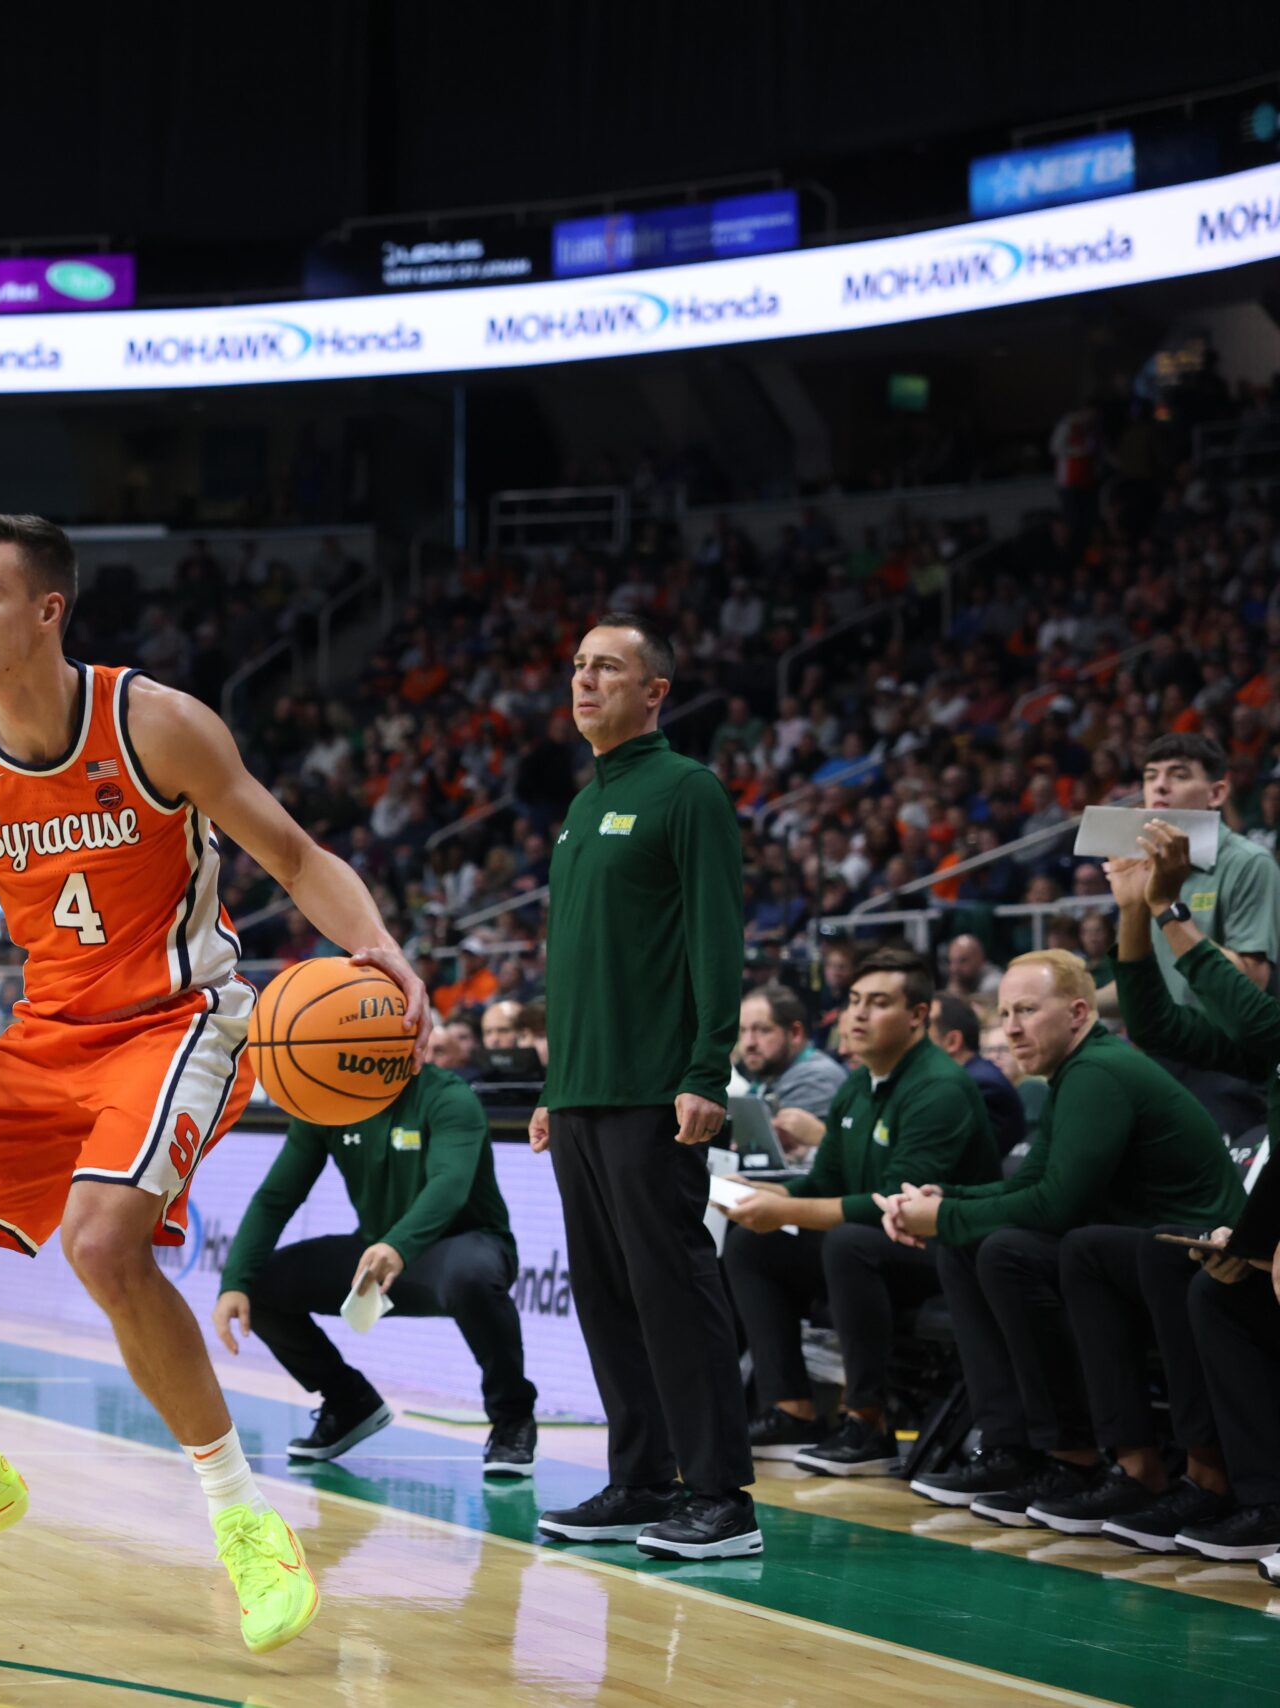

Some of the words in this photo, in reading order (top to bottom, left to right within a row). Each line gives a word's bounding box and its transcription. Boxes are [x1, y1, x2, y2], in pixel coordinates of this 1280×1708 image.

[841, 250, 997, 305] MOHAWK
[1026, 227, 1134, 275] Honda
[122, 331, 280, 367] MOHAWK
[315, 320, 423, 357] Honda
[485, 301, 643, 346] MOHAWK
[674, 288, 781, 325] Honda
[52, 870, 108, 946] 4
[515, 1249, 571, 1318] nda
